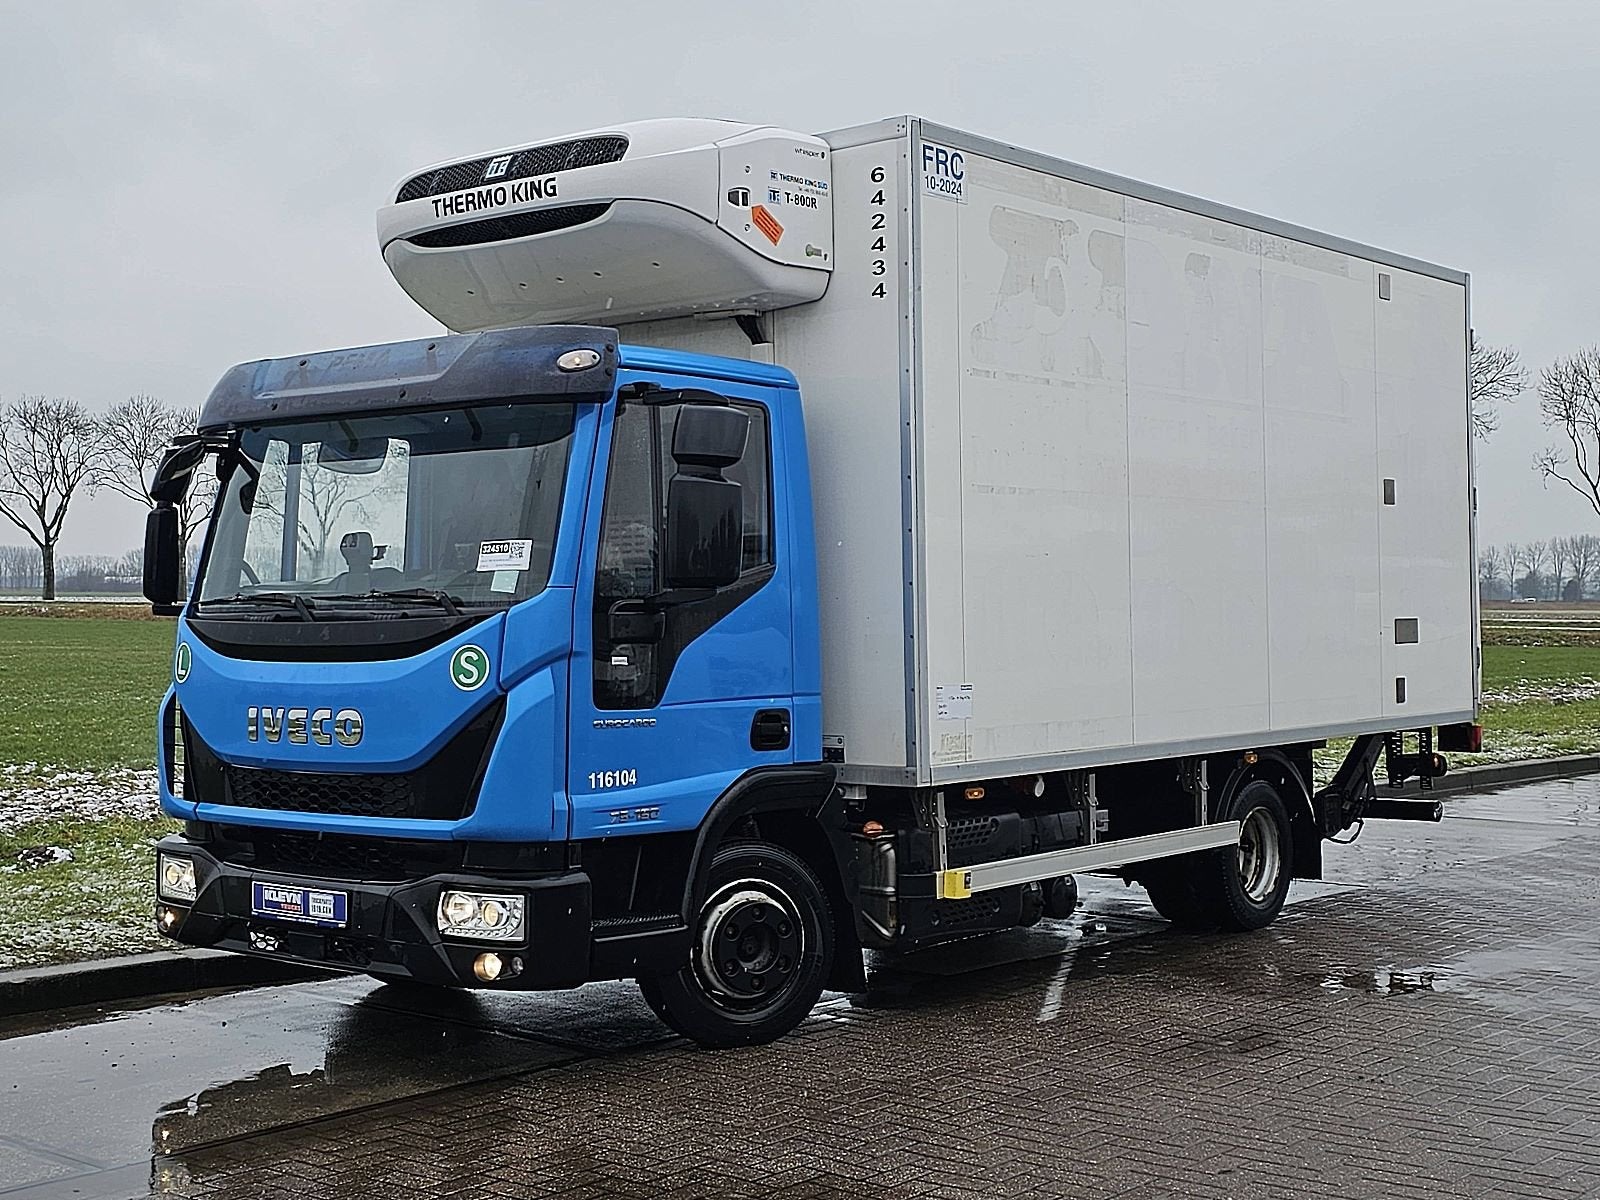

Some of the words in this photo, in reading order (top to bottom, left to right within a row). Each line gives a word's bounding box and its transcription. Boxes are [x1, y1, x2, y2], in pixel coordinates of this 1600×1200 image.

[922, 144, 964, 181] FRC
[779, 172, 804, 185] THERMO
[924, 175, 962, 196] 10-2024
[431, 186, 507, 219] THERMO
[511, 176, 558, 204] KING
[784, 191, 818, 210] T-800R
[481, 542, 510, 554] 324510
[177, 649, 187, 676] L
[458, 651, 479, 684] S
[247, 706, 364, 747] IVECO
[588, 768, 637, 789] 116104
